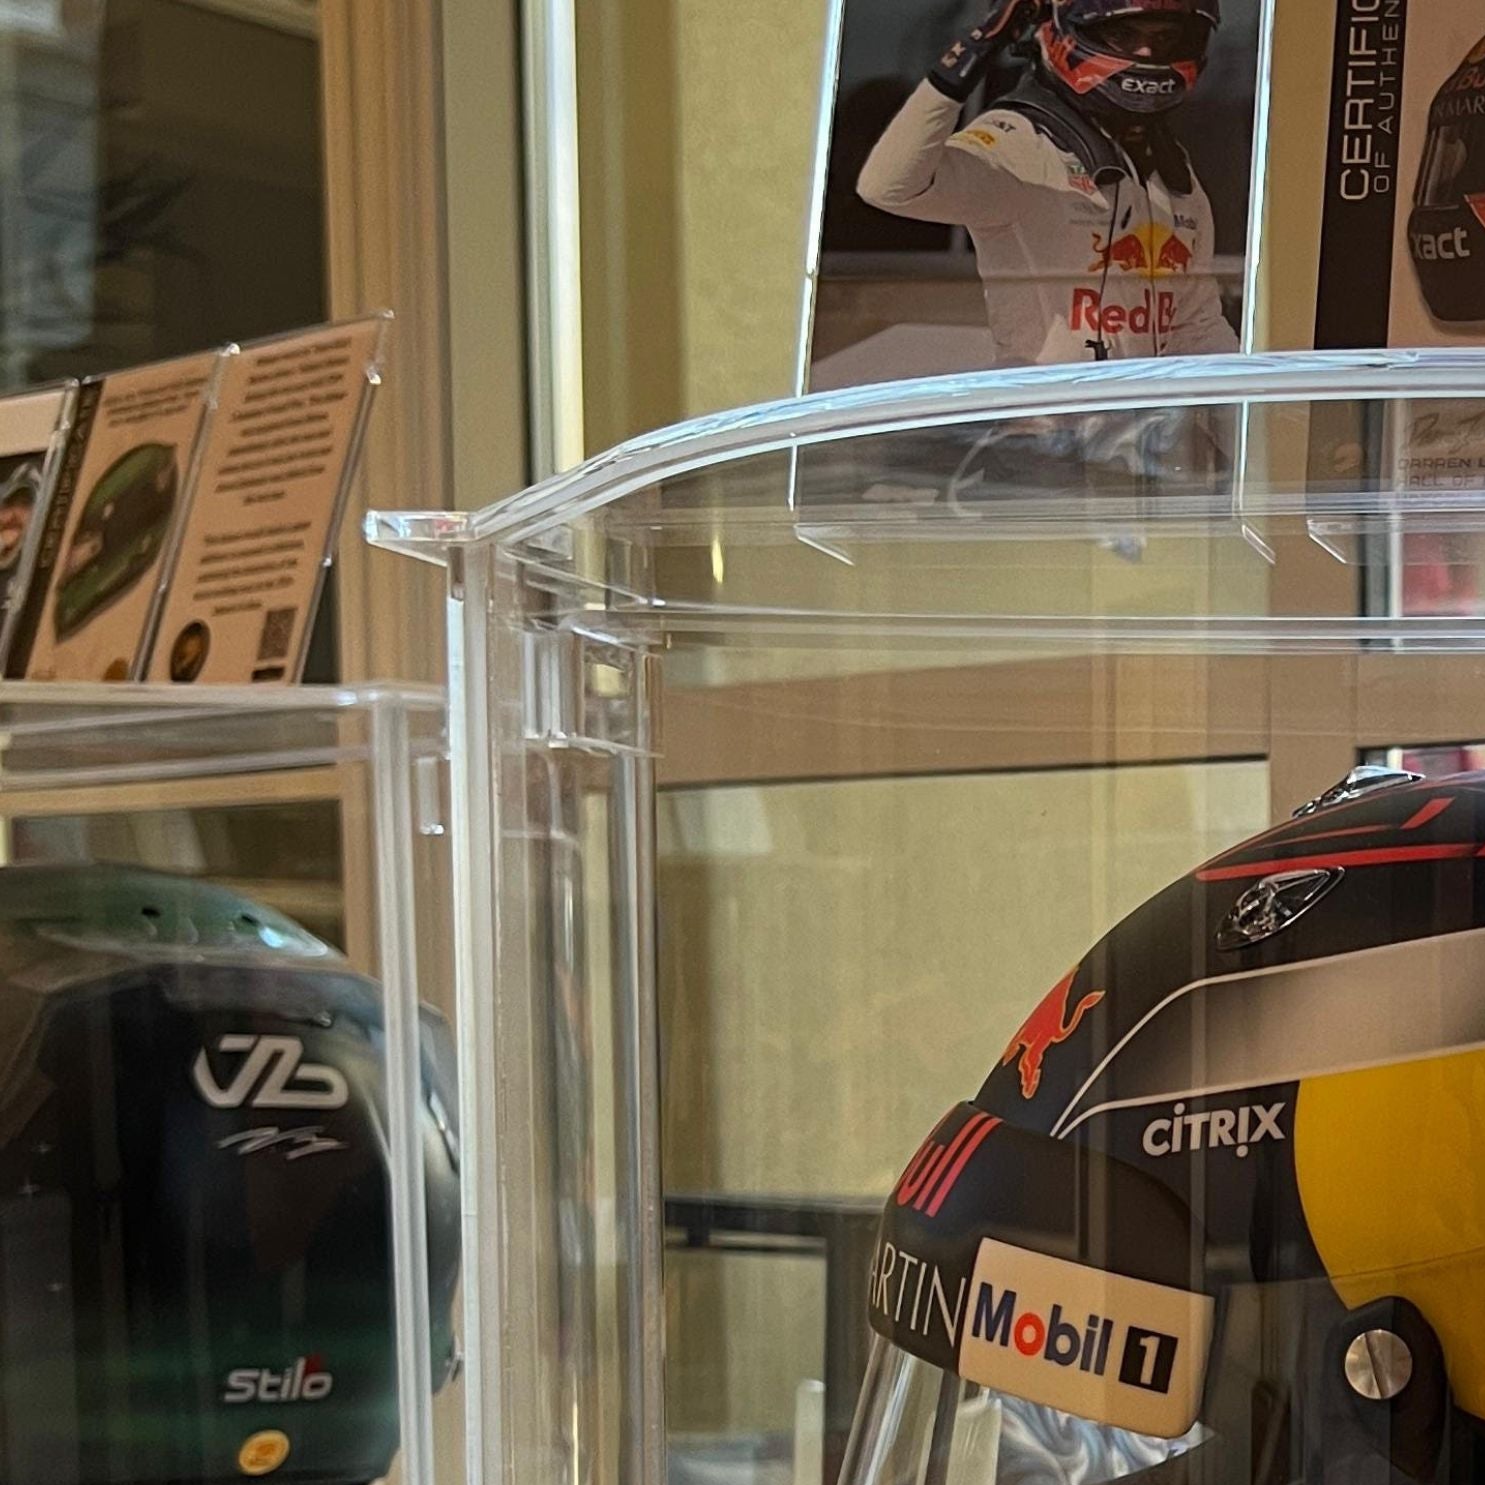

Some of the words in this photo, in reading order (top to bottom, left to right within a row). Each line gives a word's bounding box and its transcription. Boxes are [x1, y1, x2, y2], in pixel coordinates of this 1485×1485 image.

[1121, 77, 1176, 95] exact
[1373, 152, 1391, 194] OF
[1069, 287, 1153, 334] Red
[971, 1281, 1114, 1377] Mobil
